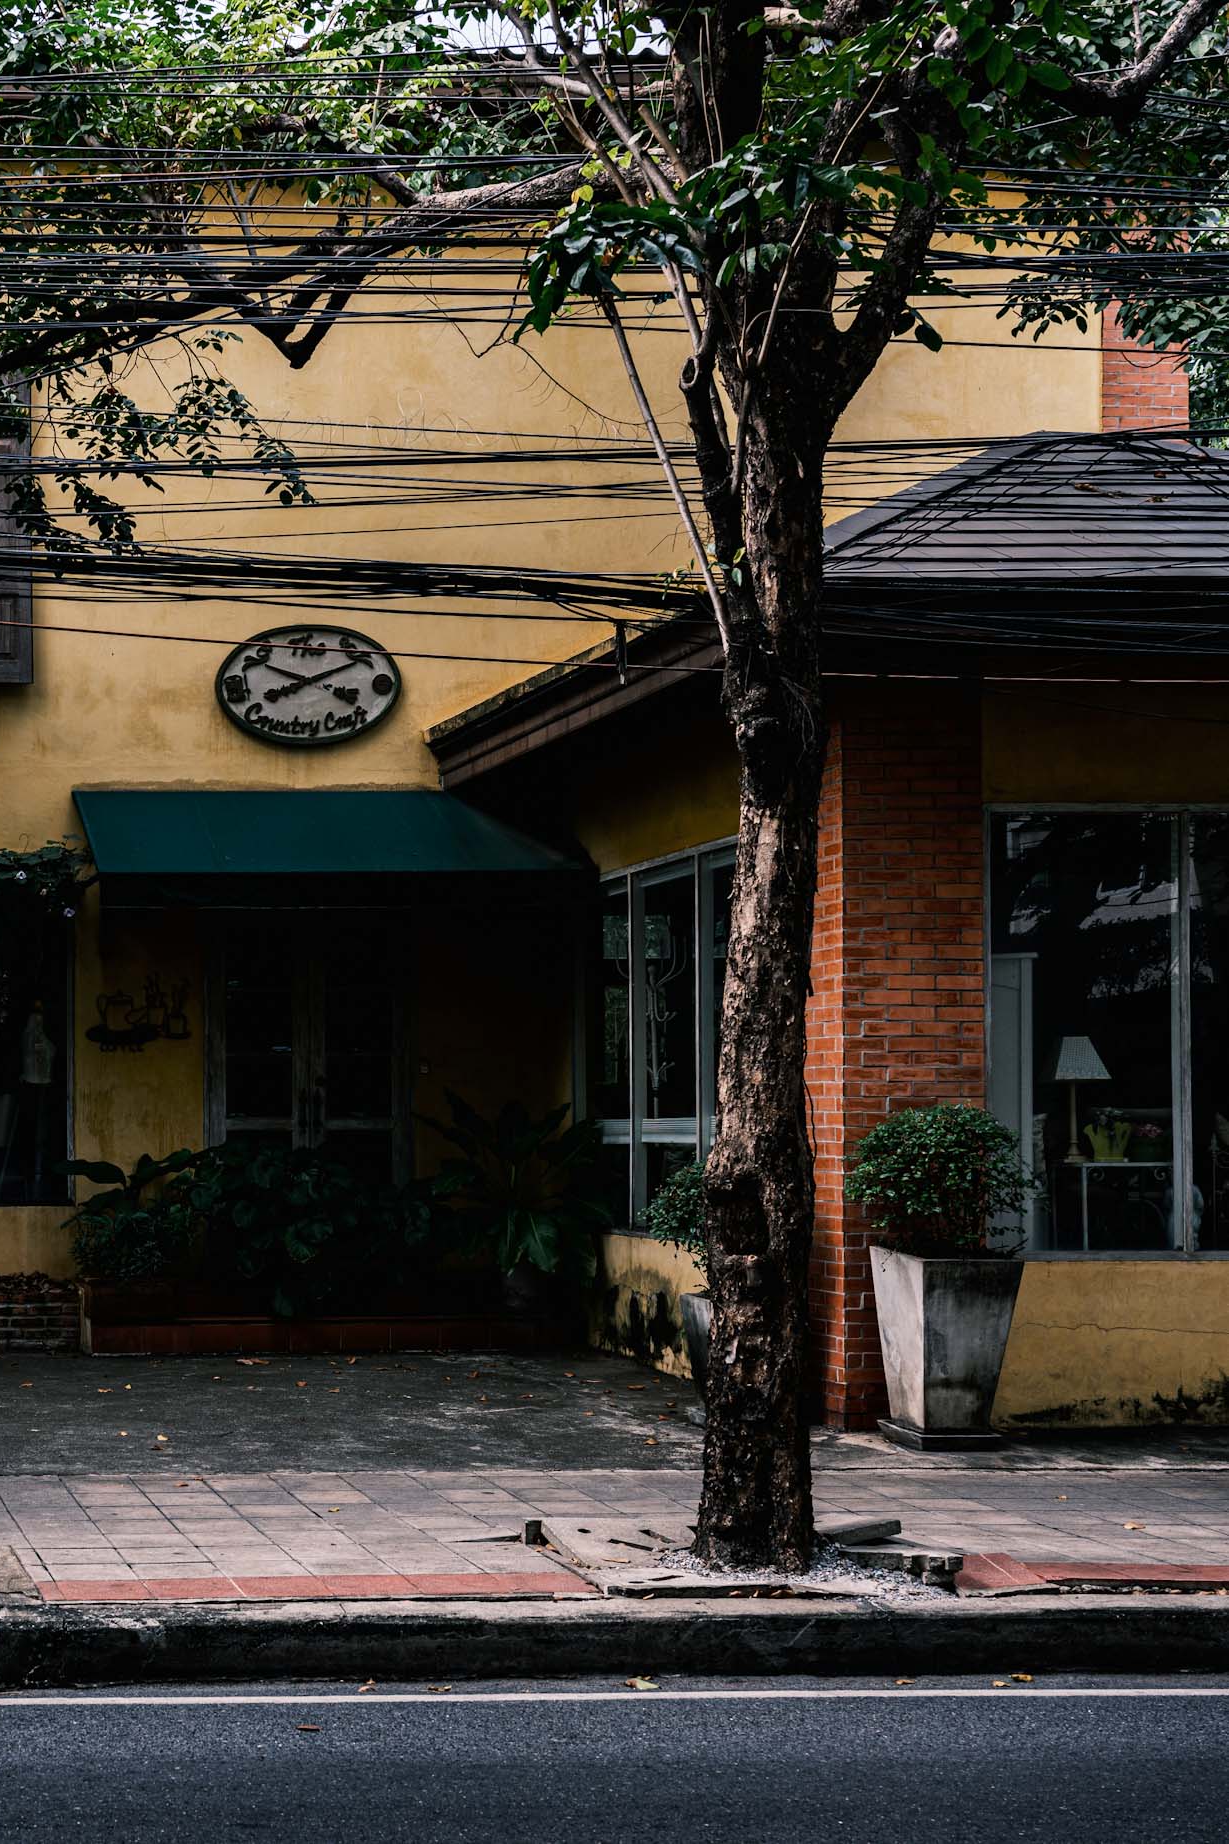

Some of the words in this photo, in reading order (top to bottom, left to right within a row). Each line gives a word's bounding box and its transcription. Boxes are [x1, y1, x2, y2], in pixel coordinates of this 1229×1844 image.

[288, 632, 326, 657] The
[244, 702, 320, 736] Country
[324, 705, 368, 732] Craft
